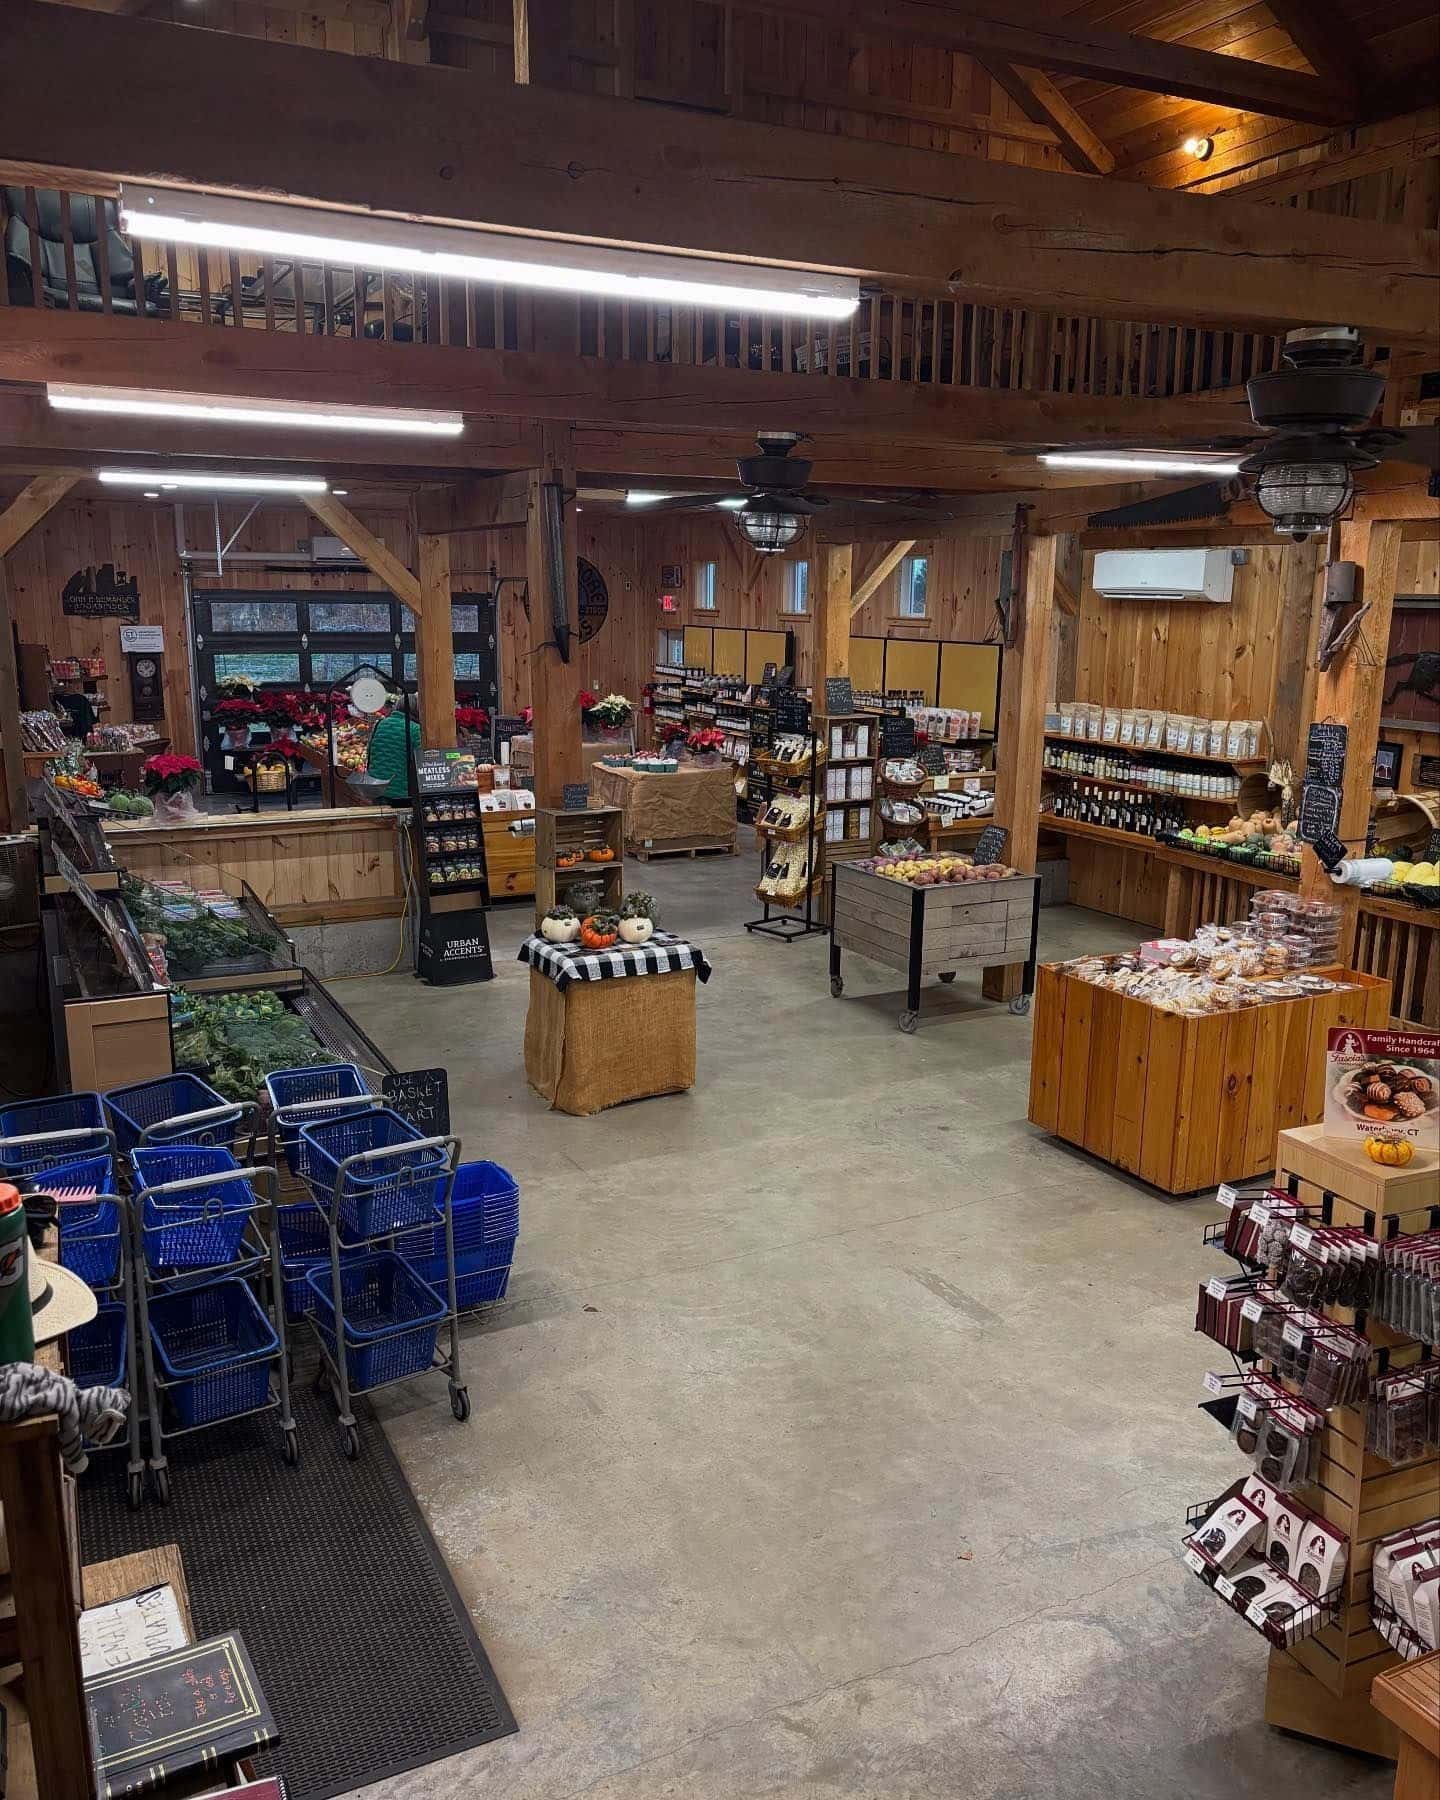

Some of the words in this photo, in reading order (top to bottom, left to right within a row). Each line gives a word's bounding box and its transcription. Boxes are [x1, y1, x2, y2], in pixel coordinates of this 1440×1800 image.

[418, 766, 451, 775] MEATLESS
[446, 937, 479, 949] URBAN
[443, 945, 484, 958] ACCENTS
[1367, 1034, 1397, 1045] Family
[1386, 1044, 1410, 1053] Since
[1412, 1046, 1435, 1055] 1964
[406, 1105, 434, 1121] ART
[1407, 1128, 1420, 1137] CT
